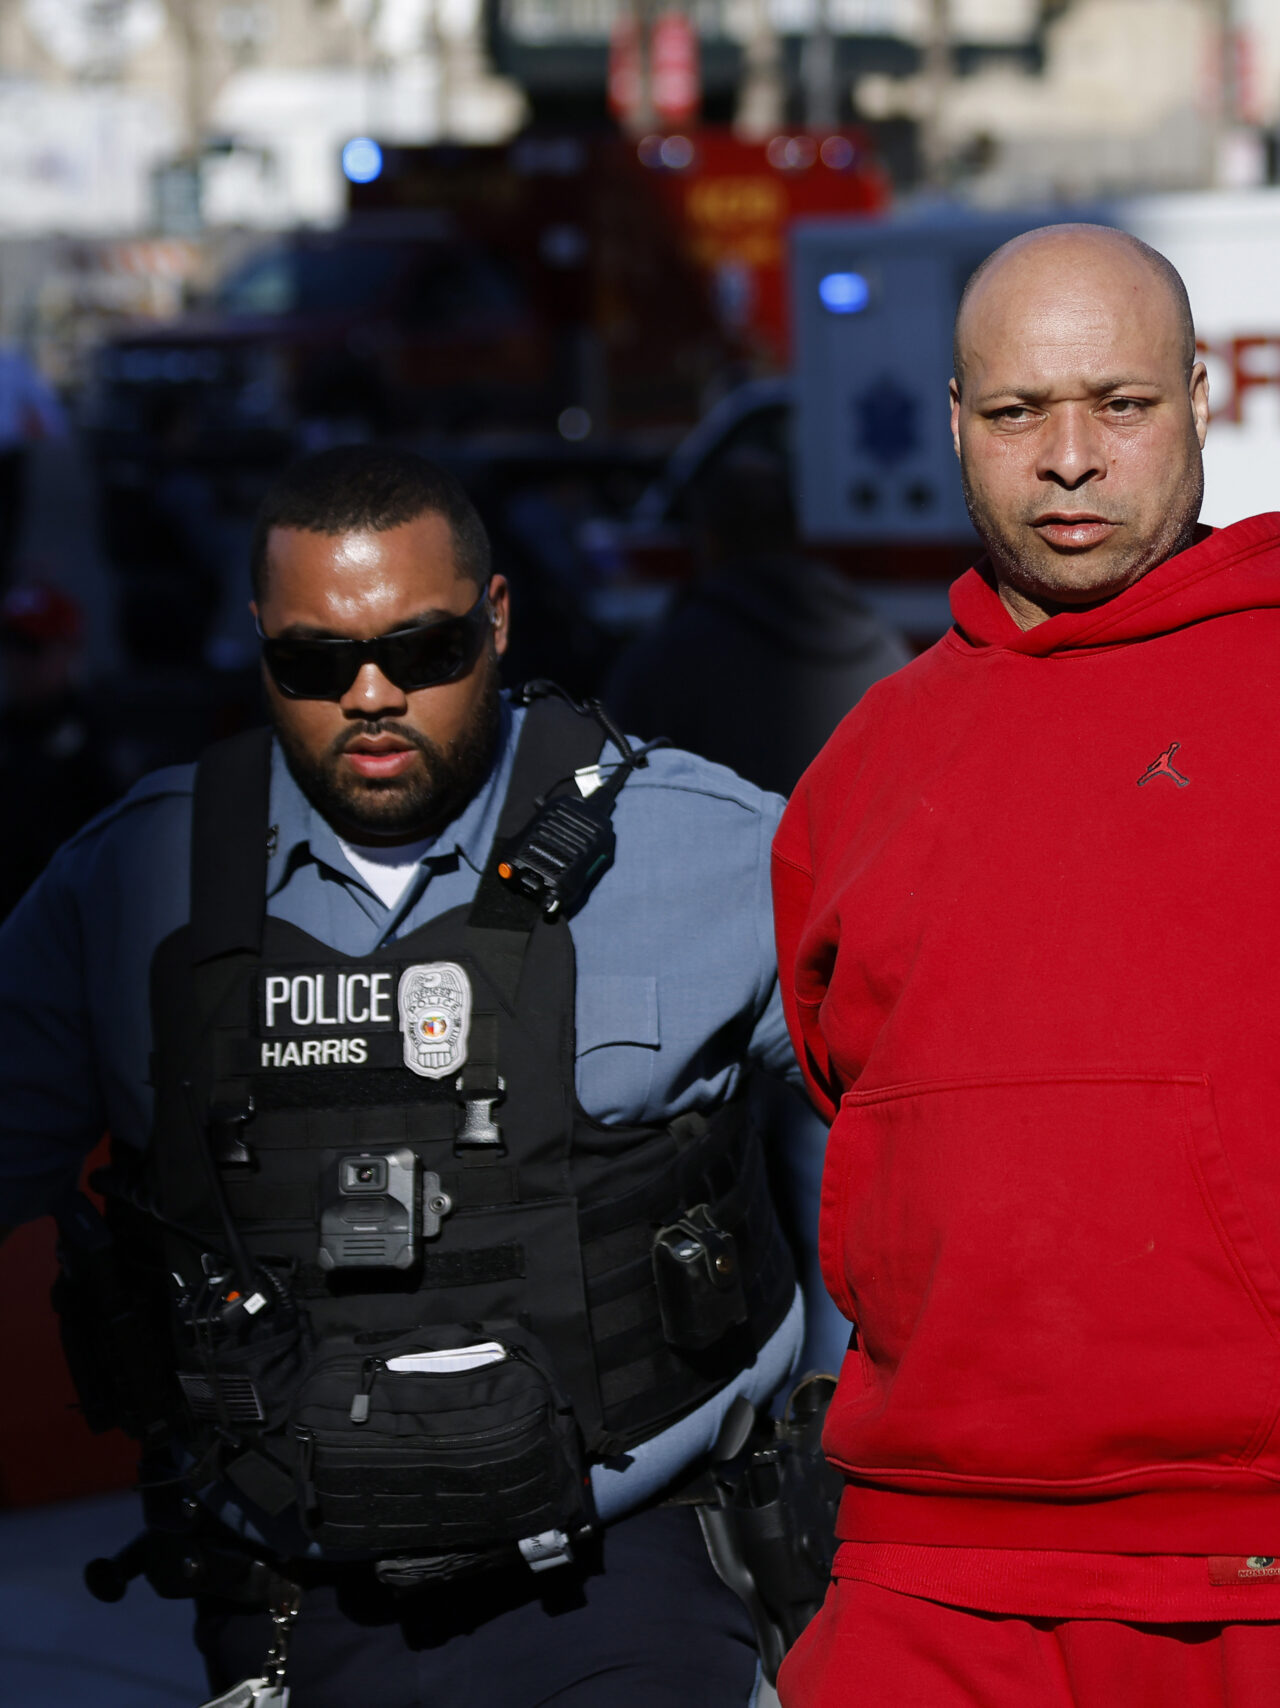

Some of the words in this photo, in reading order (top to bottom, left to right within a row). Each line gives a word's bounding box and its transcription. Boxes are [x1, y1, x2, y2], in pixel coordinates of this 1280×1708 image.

[266, 972, 392, 1027] POLICE
[408, 997, 461, 1015] POLICE
[260, 1037, 368, 1068] HARRIS
